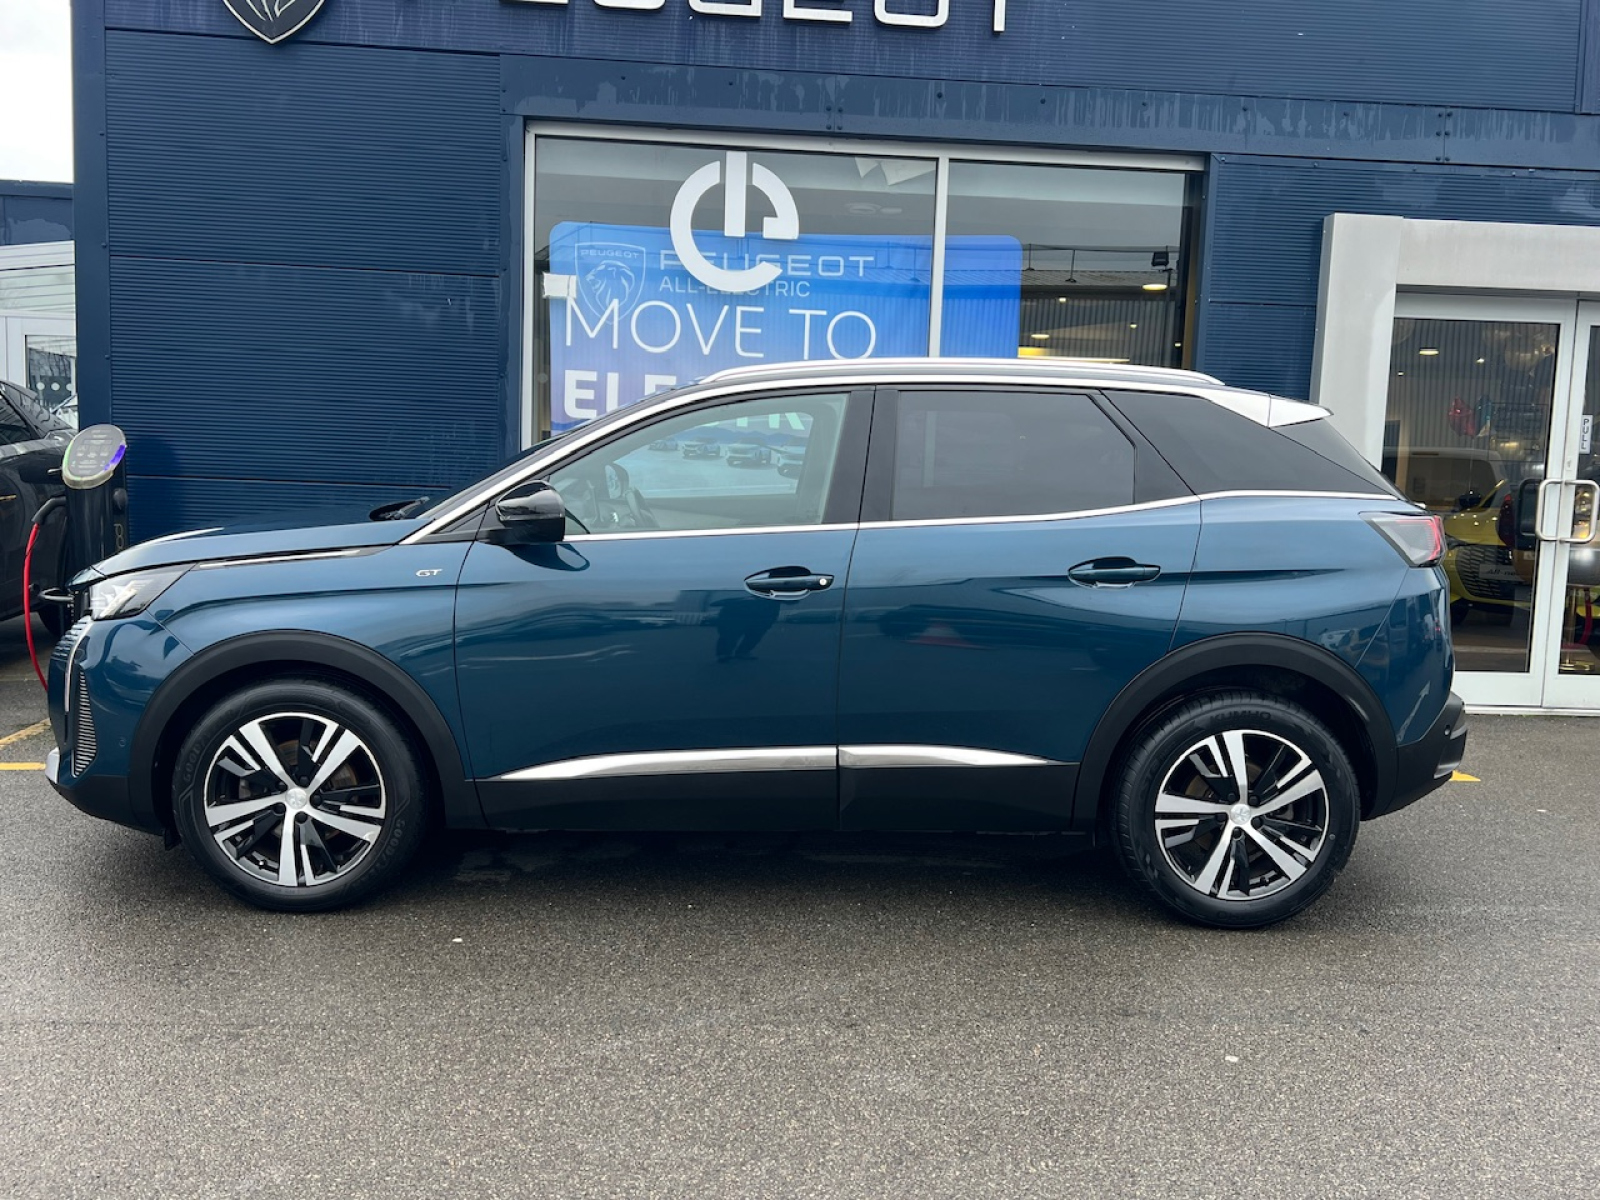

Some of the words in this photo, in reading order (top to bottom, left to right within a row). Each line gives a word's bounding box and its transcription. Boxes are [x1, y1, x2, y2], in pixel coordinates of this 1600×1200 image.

[580, 249, 639, 259] PEUGEOT
[659, 275, 810, 297] ALL-TRIC
[566, 297, 764, 357] MOVE
[789, 308, 876, 360] TO
[1581, 418, 1590, 450] PULL
[415, 568, 443, 577] GT
